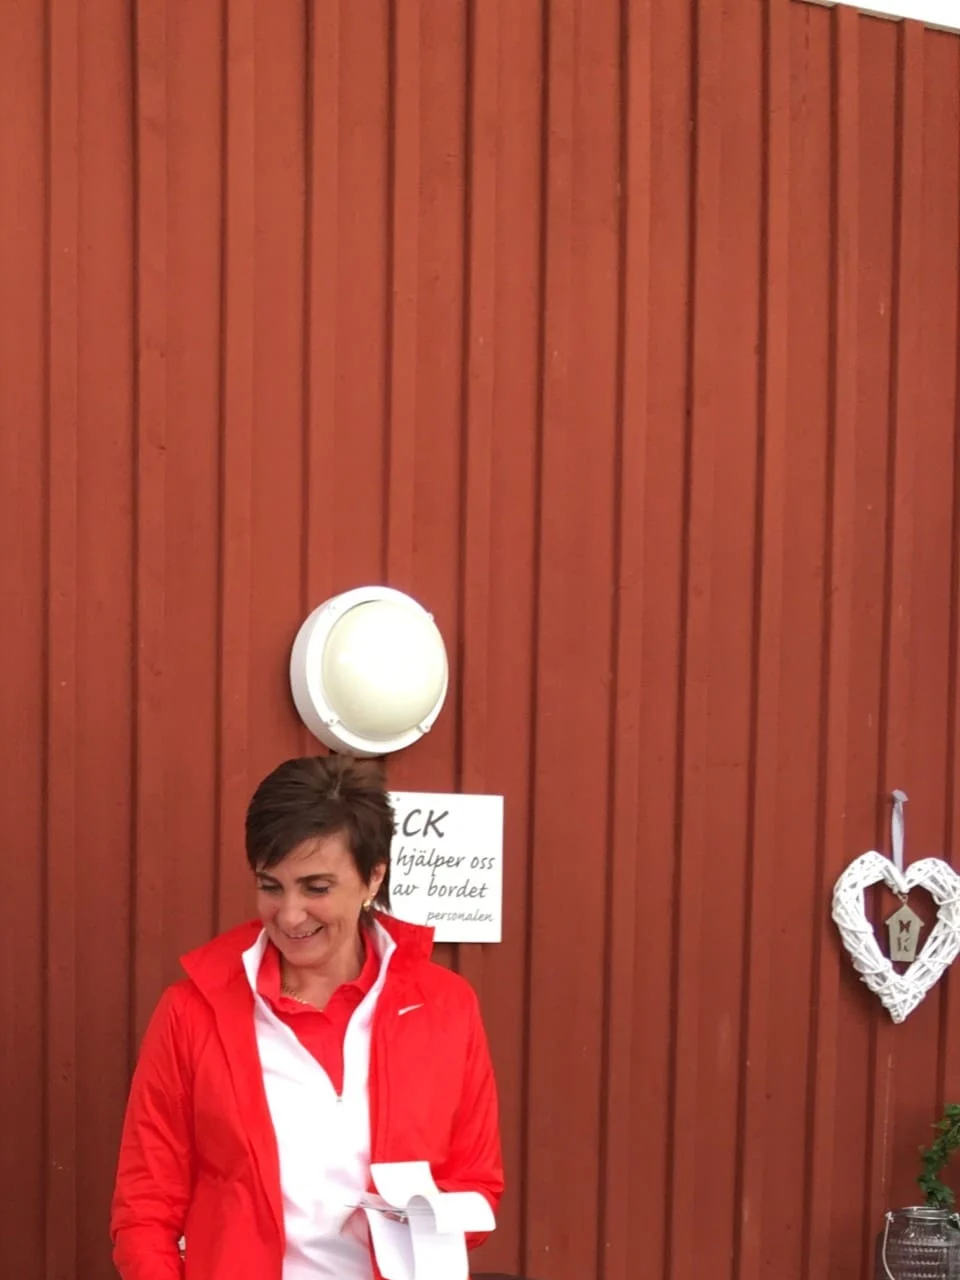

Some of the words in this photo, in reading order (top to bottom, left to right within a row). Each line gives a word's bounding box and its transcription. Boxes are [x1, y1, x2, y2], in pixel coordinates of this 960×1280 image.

[395, 846, 466, 877] hjälper
[470, 855, 496, 871] oss
[392, 882, 421, 897] av
[427, 875, 489, 899] bordet
[425, 908, 495, 927] personalen
